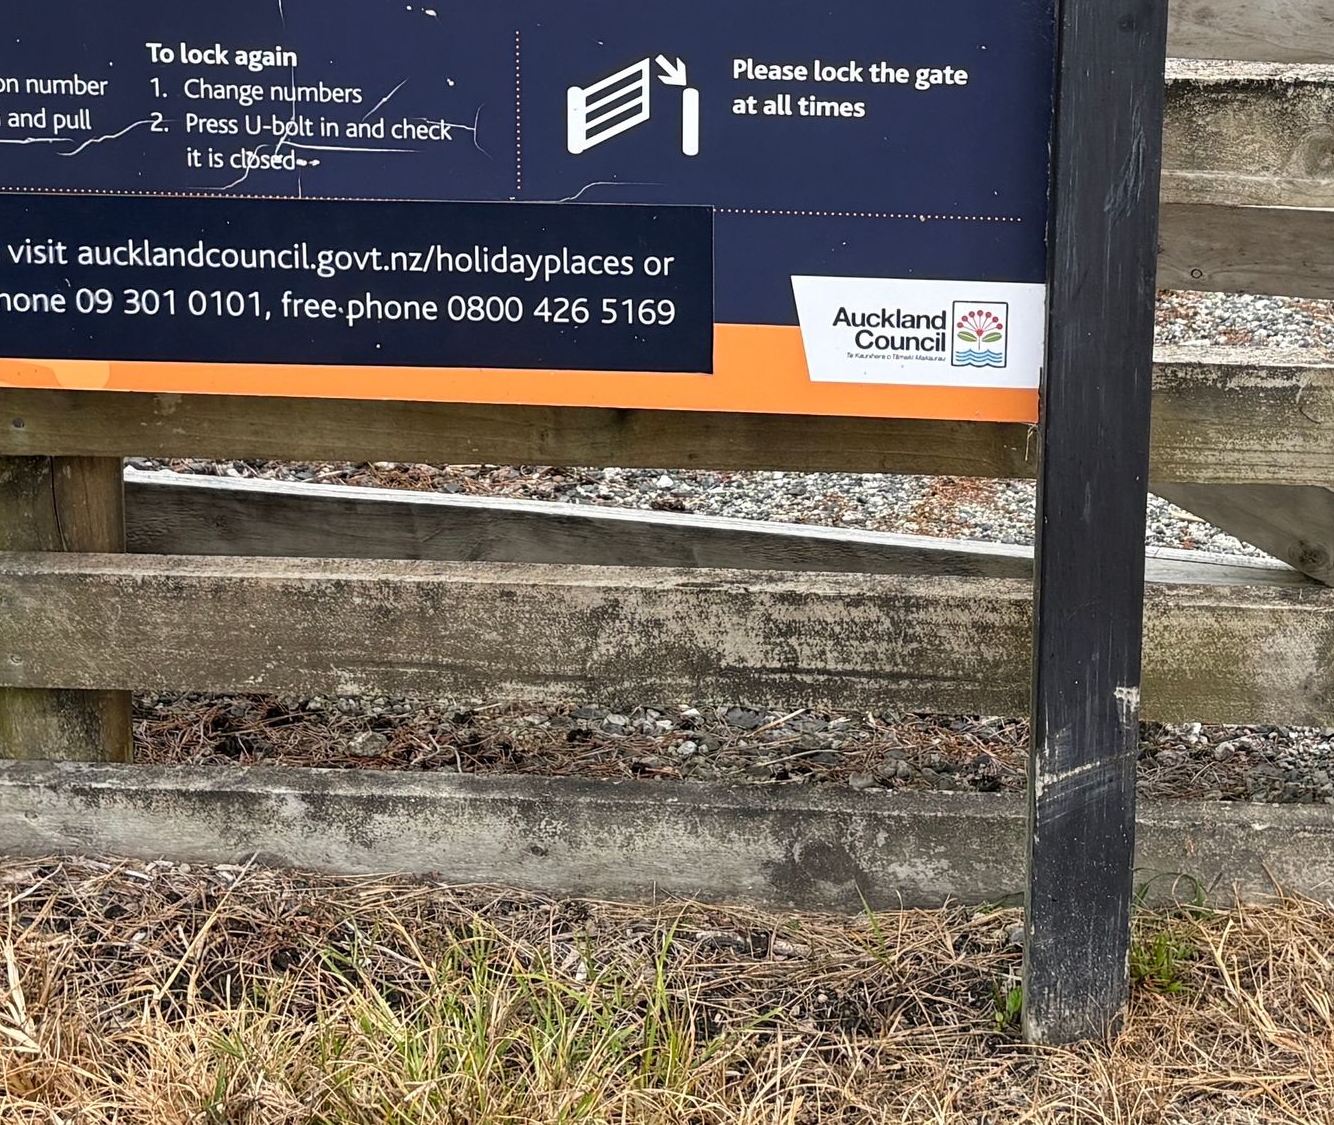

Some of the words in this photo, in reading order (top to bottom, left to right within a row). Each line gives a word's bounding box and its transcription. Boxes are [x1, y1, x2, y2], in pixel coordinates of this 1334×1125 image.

[146, 43, 174, 64] To
[180, 43, 228, 64] lock
[235, 46, 297, 71] again
[26, 74, 108, 95] number
[733, 58, 808, 80] Please
[814, 60, 863, 82] lock
[869, 61, 909, 84] the
[915, 65, 968, 90] gate
[150, 78, 167, 98] 1.
[184, 79, 264, 106] Change
[270, 81, 362, 103] numbers
[732, 96, 758, 114] at
[763, 94, 792, 115] all
[798, 95, 865, 117] times
[8, 108, 46, 129] and
[53, 109, 92, 134] pull
[150, 112, 168, 132] 2.
[186, 113, 238, 134] Press
[245, 115, 313, 137] U-bolt
[320, 117, 339, 137] in
[346, 118, 384, 139] and
[391, 118, 452, 141] check
[187, 148, 202, 168] it
[209, 148, 224, 168] is
[230, 148, 295, 170] closed
[7, 239, 67, 264] visit
[77, 239, 634, 281] aucklandcouncil.govt.nz/holidayplaces
[643, 255, 674, 276] or
[76, 287, 112, 314] 09
[123, 289, 176, 315] 301
[188, 289, 271, 321] 0101,
[282, 291, 337, 318] free
[346, 293, 437, 326] phone
[447, 295, 523, 322] 0800
[533, 297, 590, 323] 426
[601, 298, 676, 326] 5169
[833, 307, 946, 330] Auckland
[855, 329, 946, 352] Council
